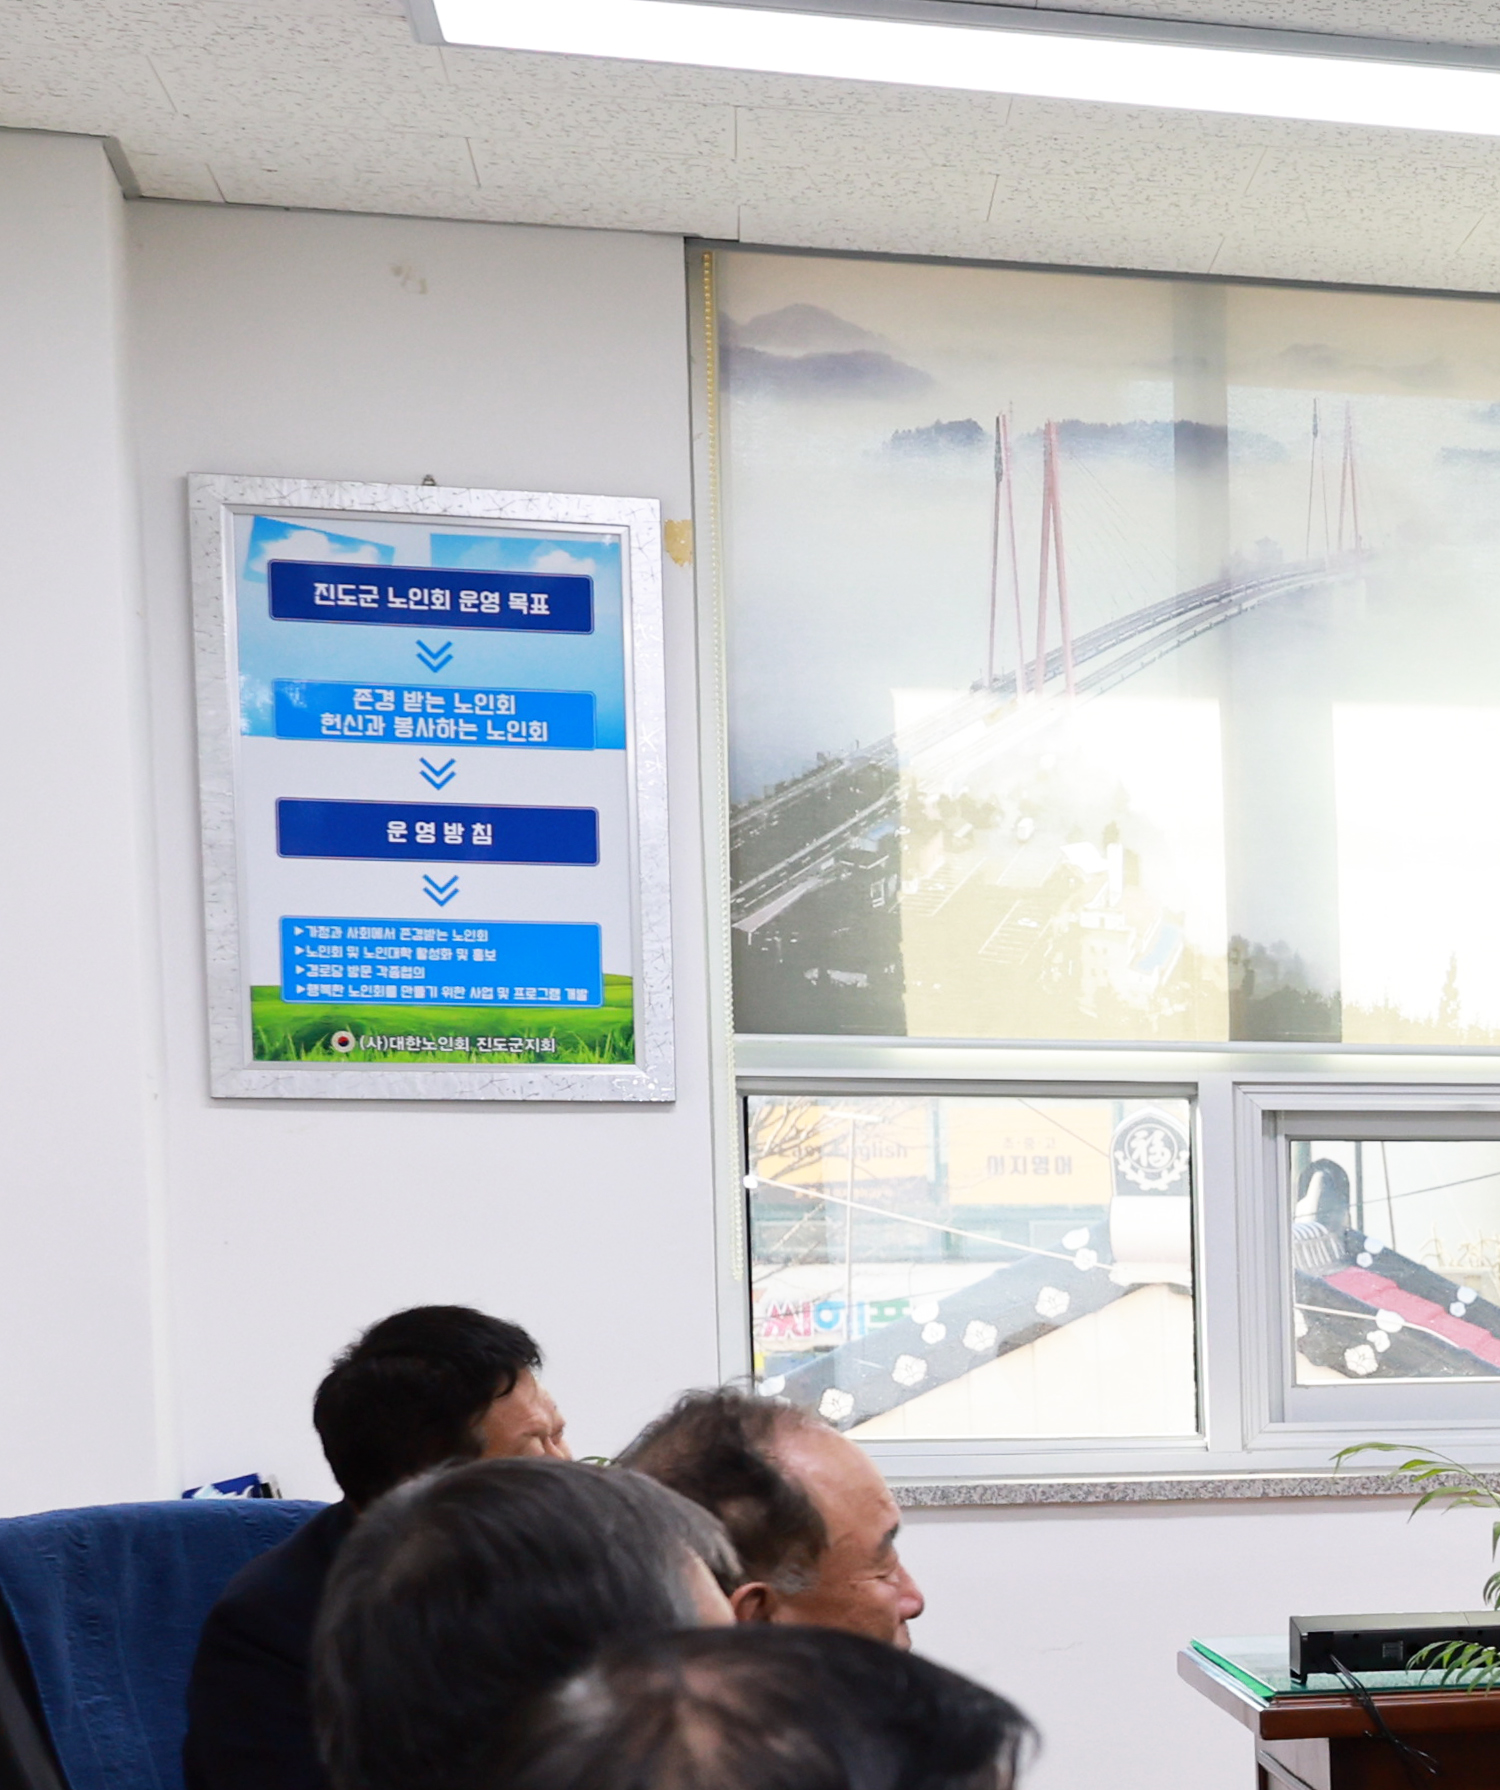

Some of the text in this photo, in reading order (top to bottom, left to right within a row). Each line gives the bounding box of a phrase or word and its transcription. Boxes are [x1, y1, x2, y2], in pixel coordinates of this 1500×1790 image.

[313, 582, 550, 616] 진도군 노인회 운영 목표
[353, 689, 516, 715] 존경 받는 노인회
[320, 713, 548, 742] 헌신과 봉사하는 노인회
[305, 925, 488, 942] 가정과 사회에서 존경받는 노인회
[306, 946, 343, 958] 노인회
[347, 946, 358, 959] 및
[363, 947, 413, 960] 노인대학
[456, 949, 468, 962] 및
[472, 949, 496, 962] 홍보
[306, 964, 425, 979] 경로당 방문 각종협의
[306, 983, 588, 1001] 행복한 노인회를 만들기 위한 사업 및 프로그램 개발
[360, 1036, 556, 1053] (사)대한노인회 진도군지회
[1130, 1130, 1175, 1167] 福
